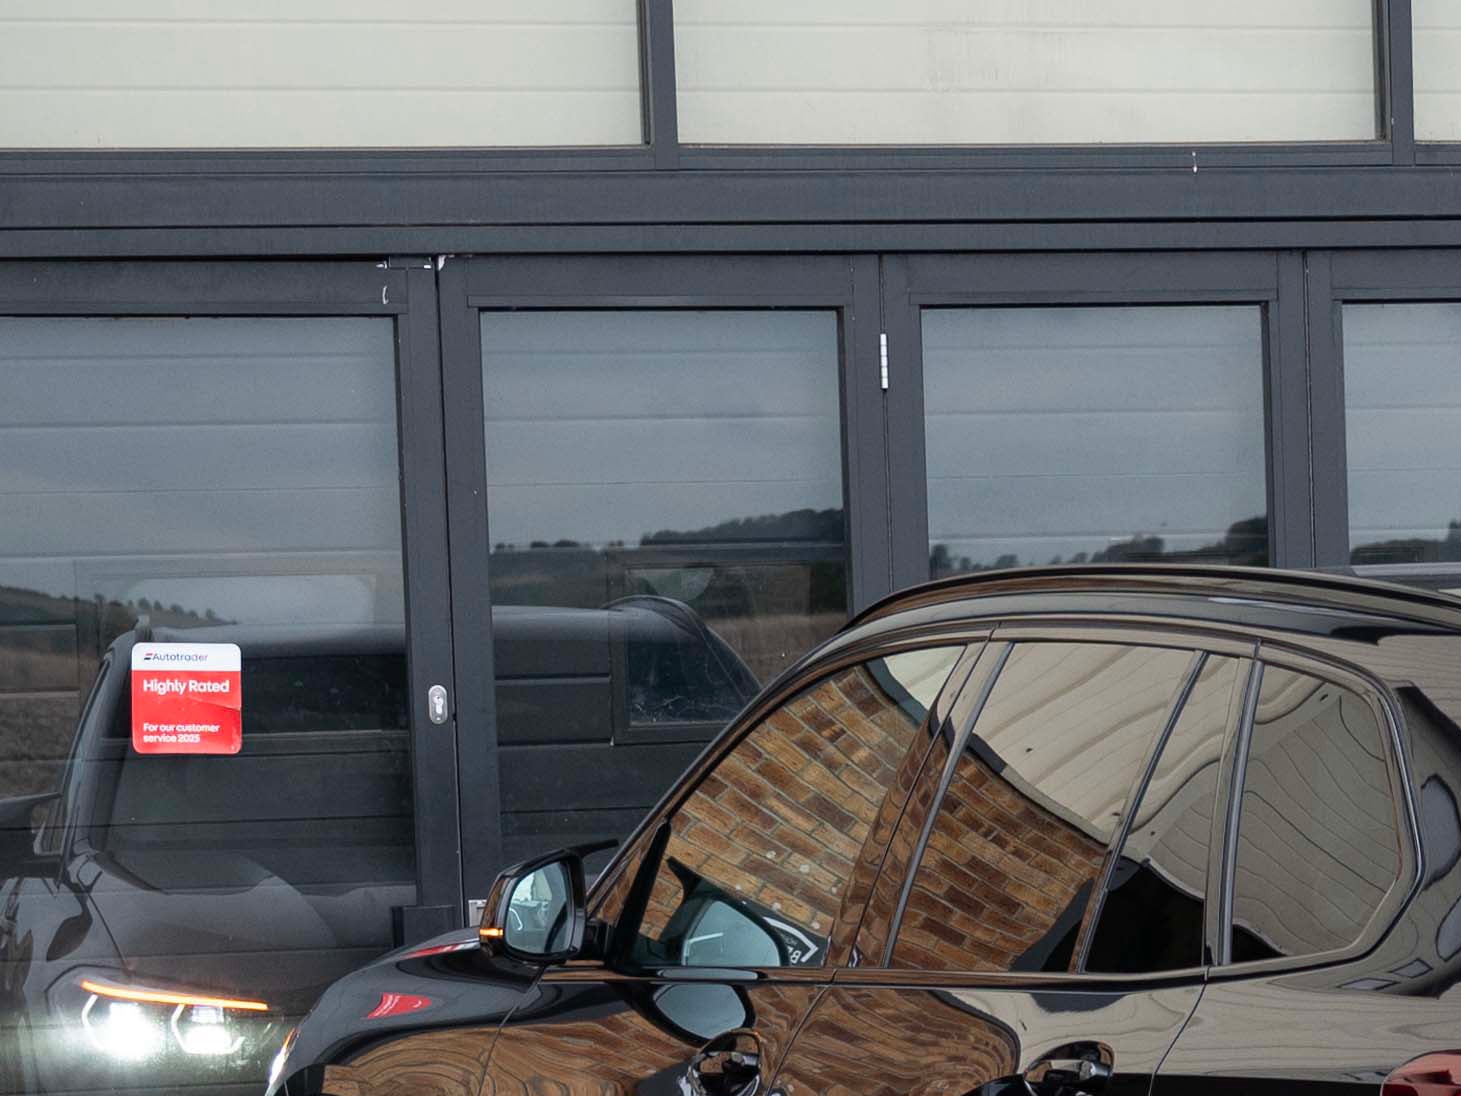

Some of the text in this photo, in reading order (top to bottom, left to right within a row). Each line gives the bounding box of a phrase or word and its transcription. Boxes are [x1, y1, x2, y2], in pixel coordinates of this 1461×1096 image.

[152, 652, 208, 662] Autotrader
[143, 679, 230, 695] Highly Rated
[143, 722, 220, 732] For our customer
[143, 733, 177, 743] service
